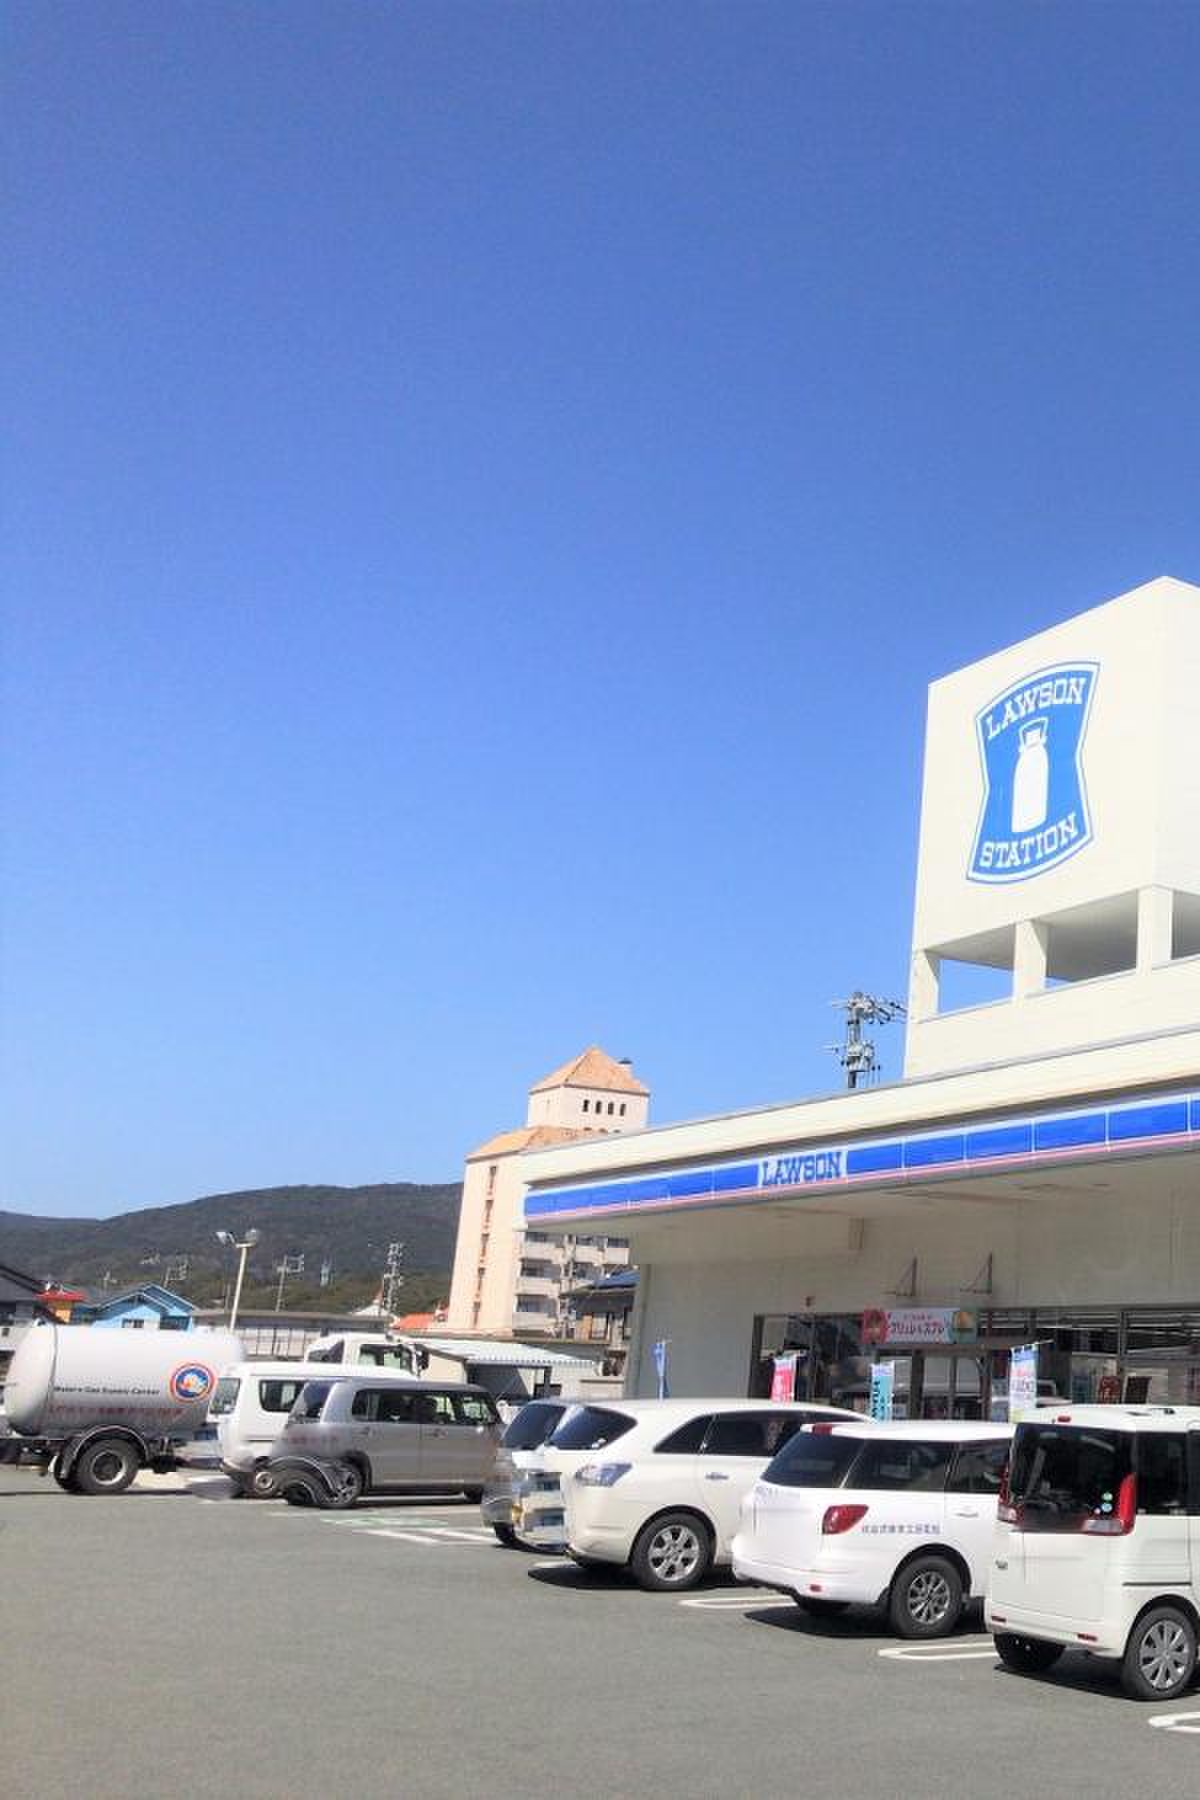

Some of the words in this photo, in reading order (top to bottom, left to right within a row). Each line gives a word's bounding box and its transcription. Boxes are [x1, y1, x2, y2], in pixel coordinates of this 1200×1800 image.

[987, 676, 1087, 741] LAWSON
[979, 812, 1079, 868] STATION
[761, 1151, 842, 1185] LAWSON
